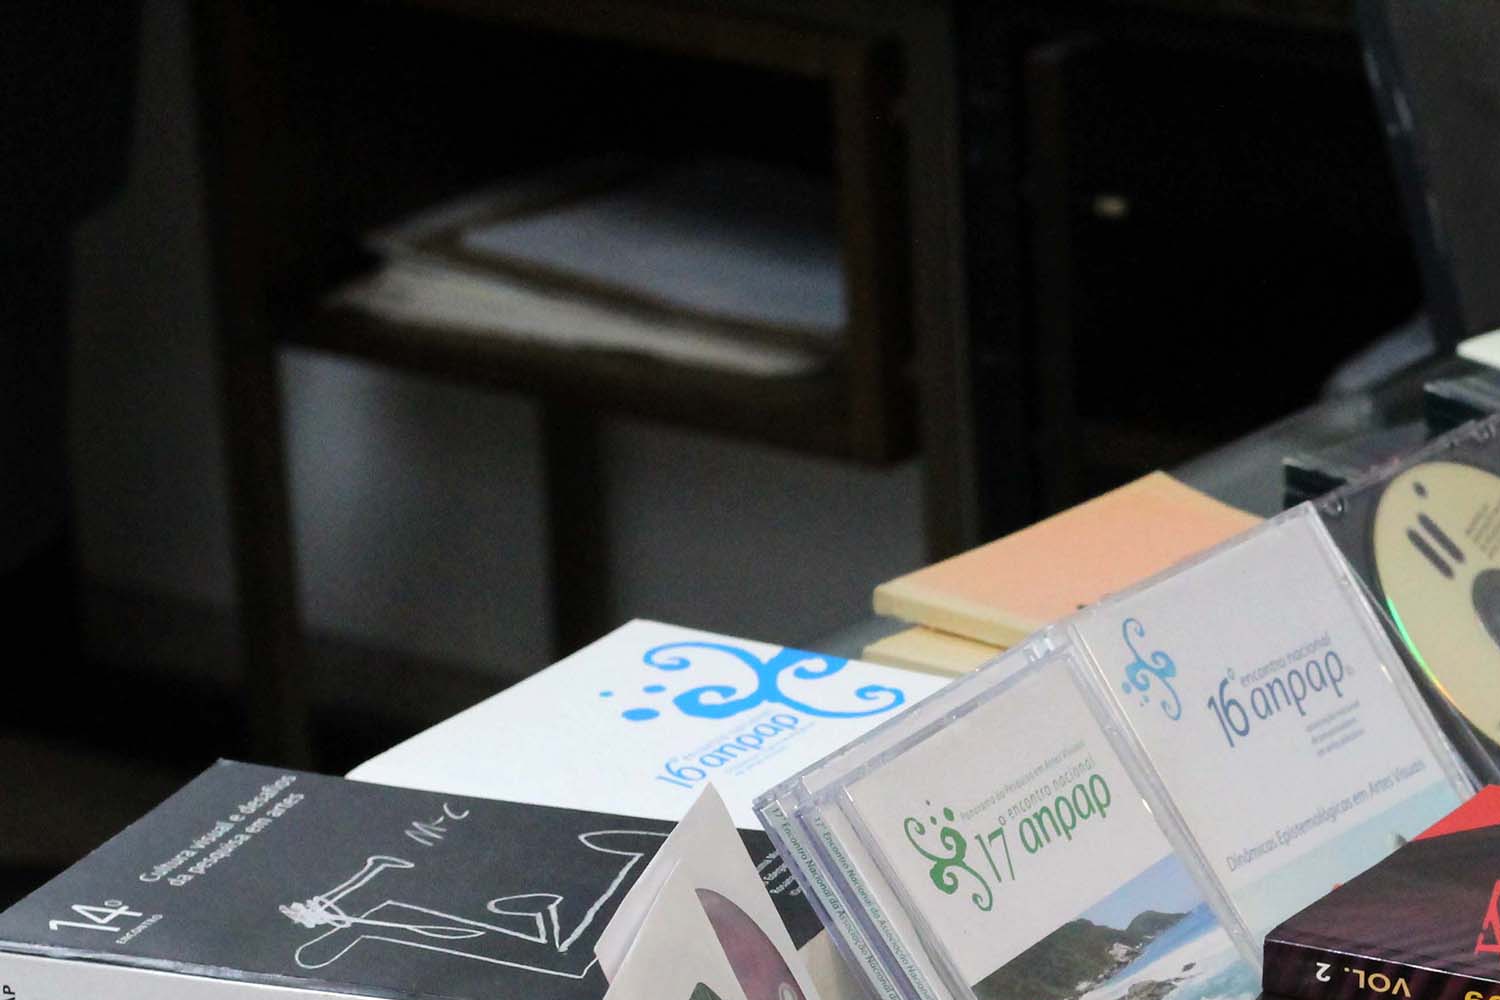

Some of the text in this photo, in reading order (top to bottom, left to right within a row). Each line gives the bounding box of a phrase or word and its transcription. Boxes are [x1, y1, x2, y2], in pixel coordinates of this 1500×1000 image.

[1249, 650, 1345, 721] anpap
[699, 713, 800, 769] anpap
[1019, 774, 1111, 854] anpap
[803, 858, 834, 898] Nacional
[1314, 961, 1411, 998] VOL. 2
